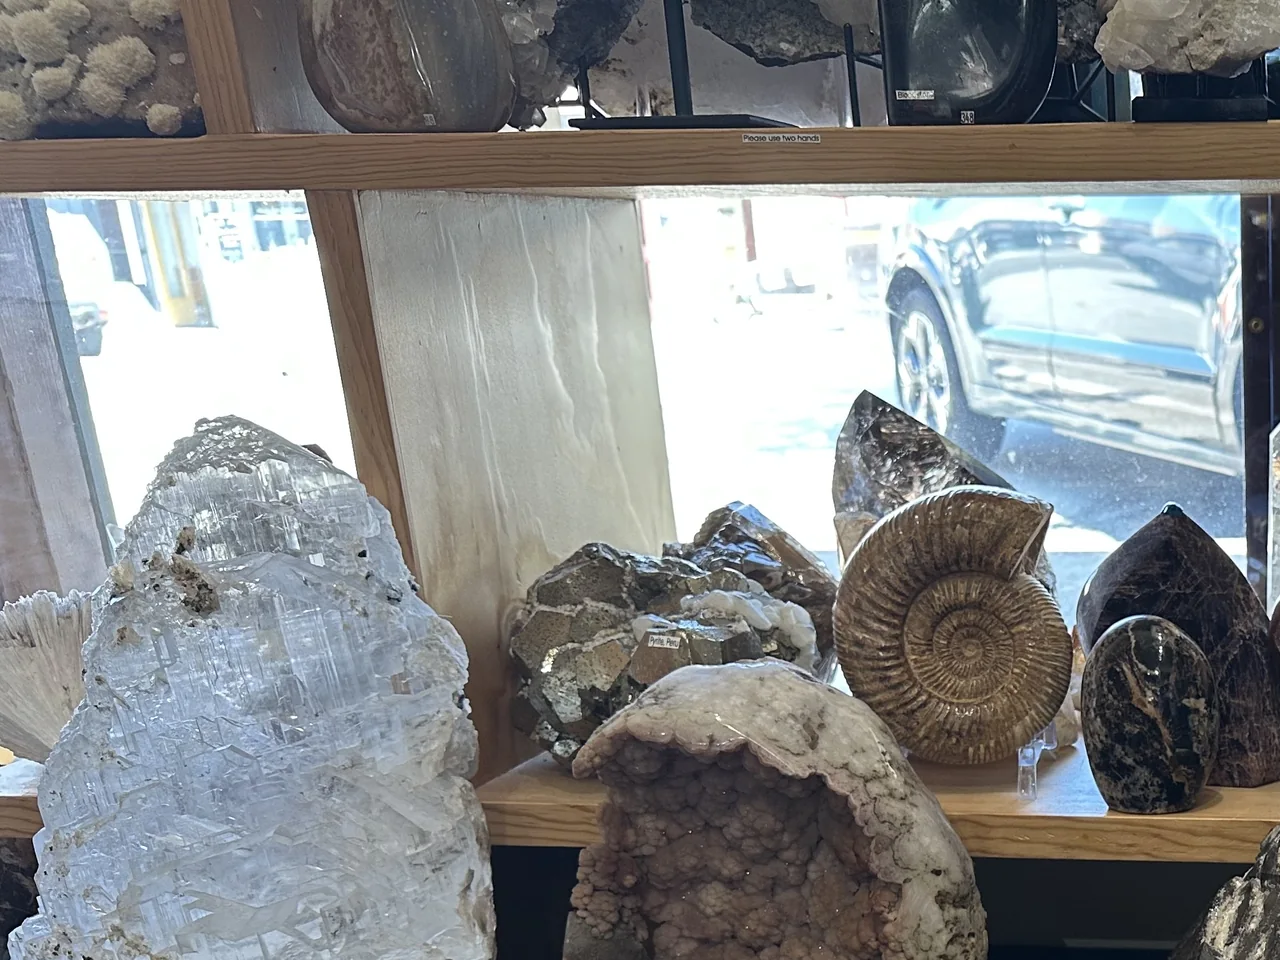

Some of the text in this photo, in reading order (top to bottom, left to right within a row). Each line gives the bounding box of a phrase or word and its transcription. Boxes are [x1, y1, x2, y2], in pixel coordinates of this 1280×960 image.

[743, 134, 767, 142] Please
[782, 134, 797, 142] two
[797, 134, 820, 142] hands
